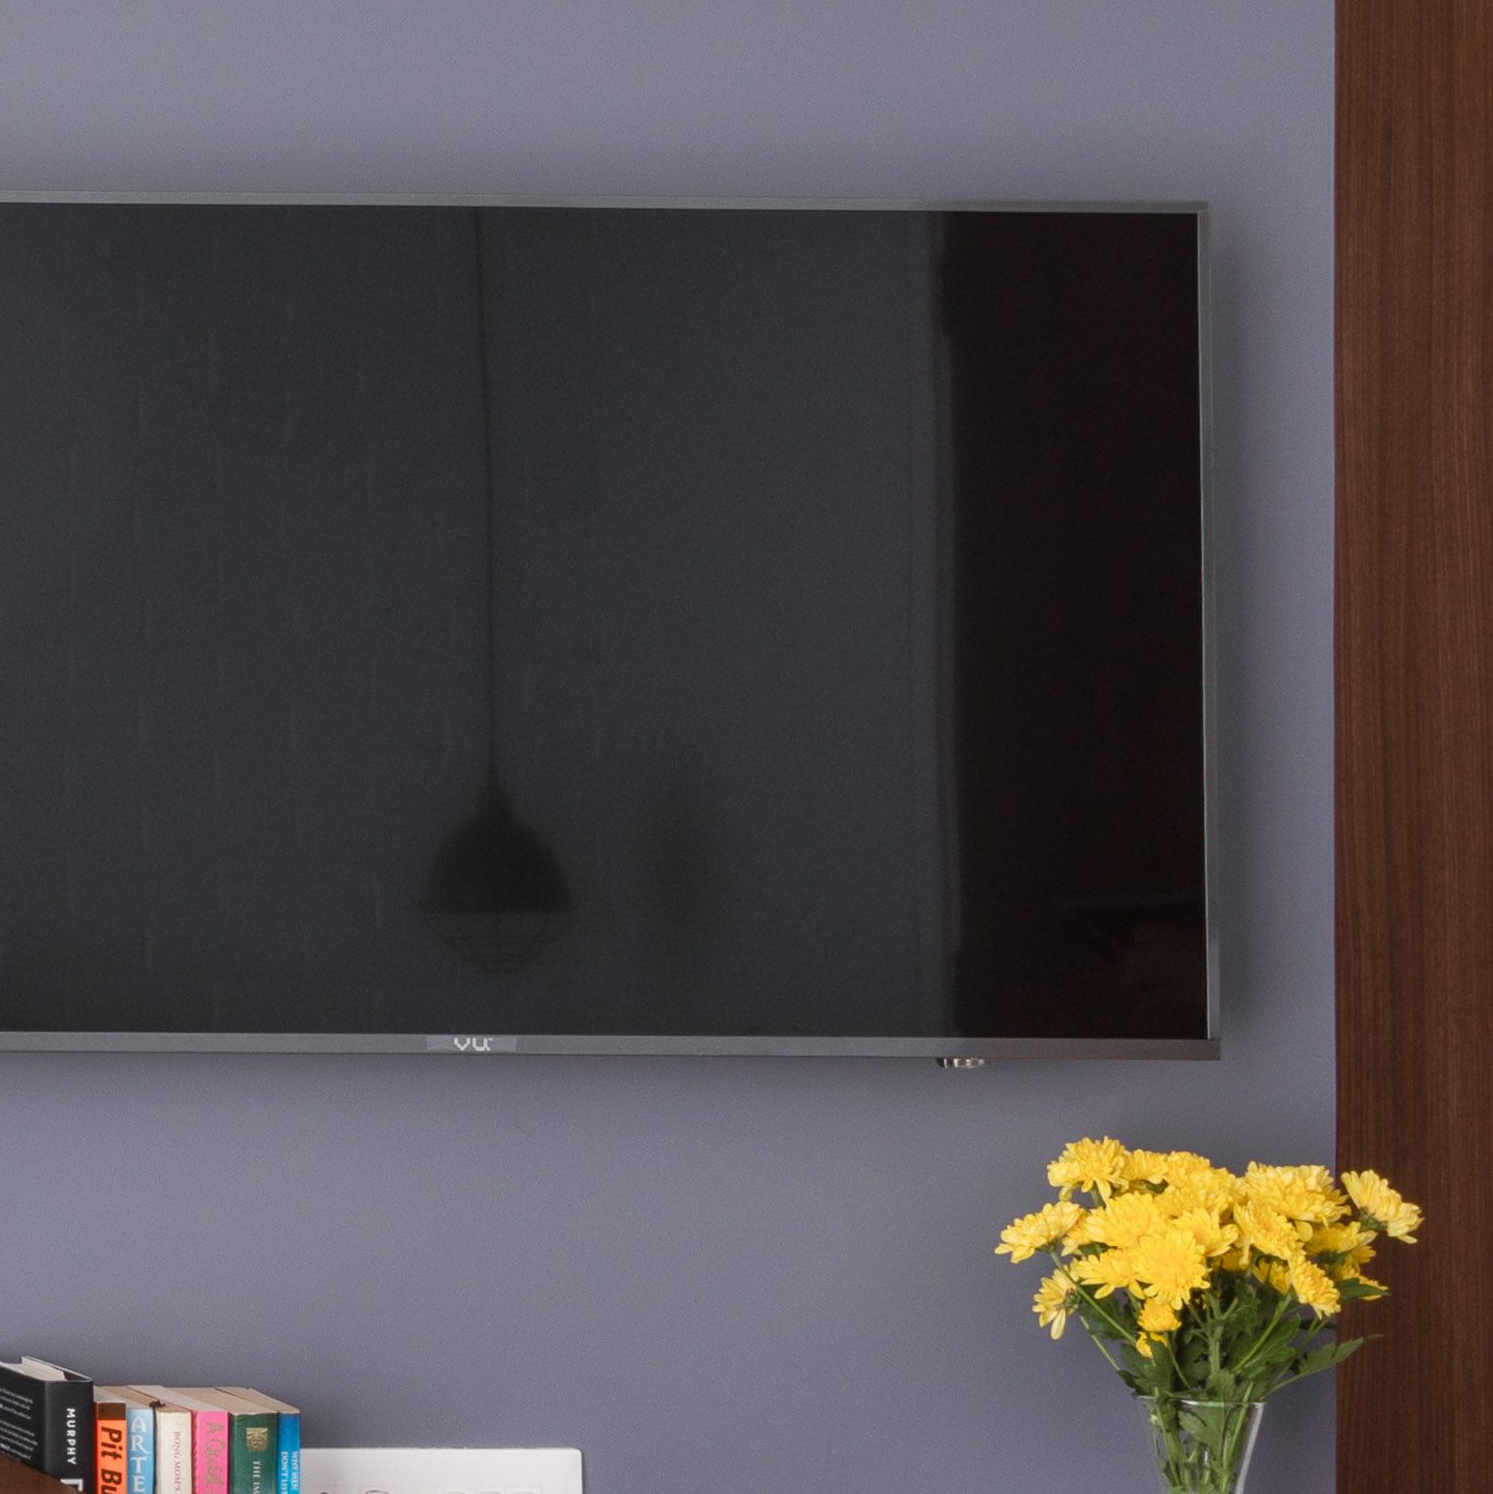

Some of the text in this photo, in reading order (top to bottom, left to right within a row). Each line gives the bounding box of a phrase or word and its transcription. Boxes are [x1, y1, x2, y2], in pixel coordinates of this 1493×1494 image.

[66, 1408, 77, 1465] MURPHY
[101, 1426, 123, 1460] Pit
[206, 1422, 223, 1435] A
[173, 1431, 182, 1458] BONG
[173, 1461, 182, 1492] MOM'S
[252, 1461, 261, 1478] THE
[281, 1451, 289, 1477] DON'T
[291, 1451, 299, 1491] WHY MEN
